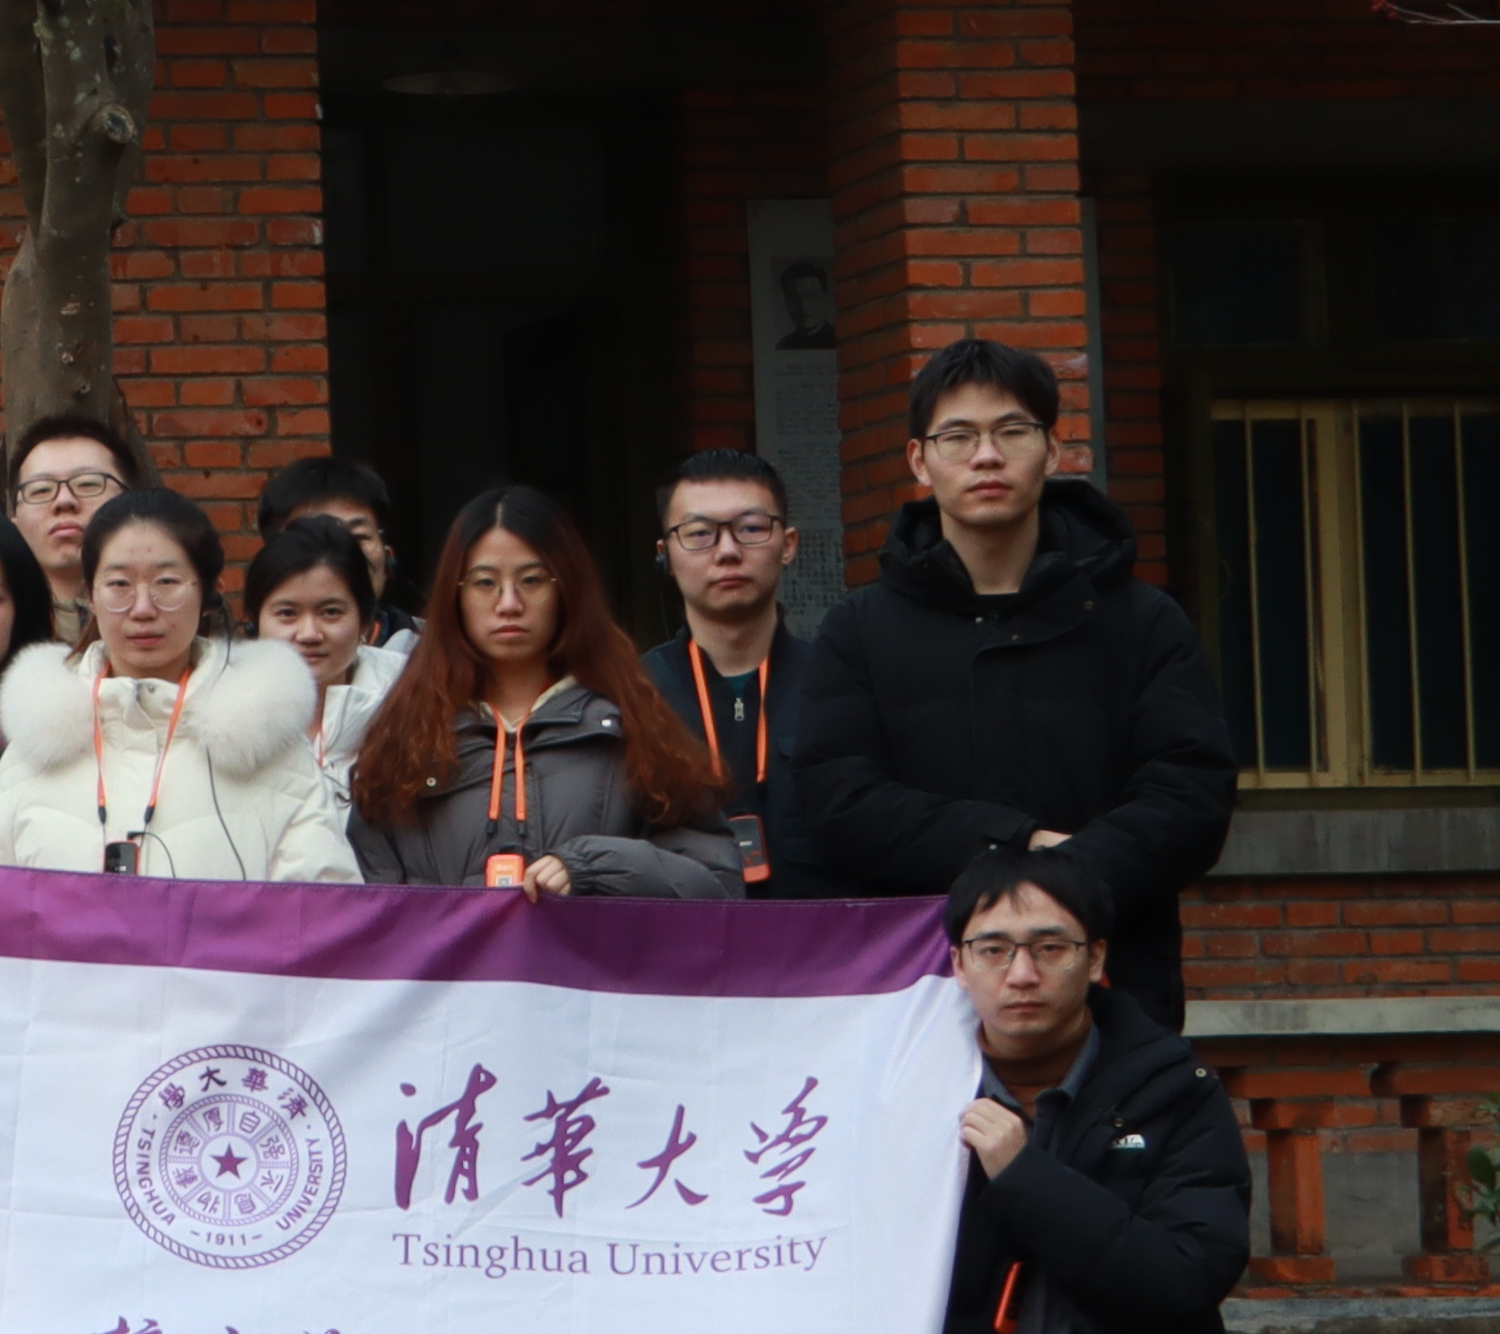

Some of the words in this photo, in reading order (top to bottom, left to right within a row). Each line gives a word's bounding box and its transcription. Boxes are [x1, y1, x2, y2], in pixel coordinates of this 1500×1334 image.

[136, 1127, 177, 1227] TSINGHUA
[275, 1137, 325, 1231] UNIVERSITY
[391, 1232, 590, 1281] Tsinghua
[607, 1230, 828, 1277] University
